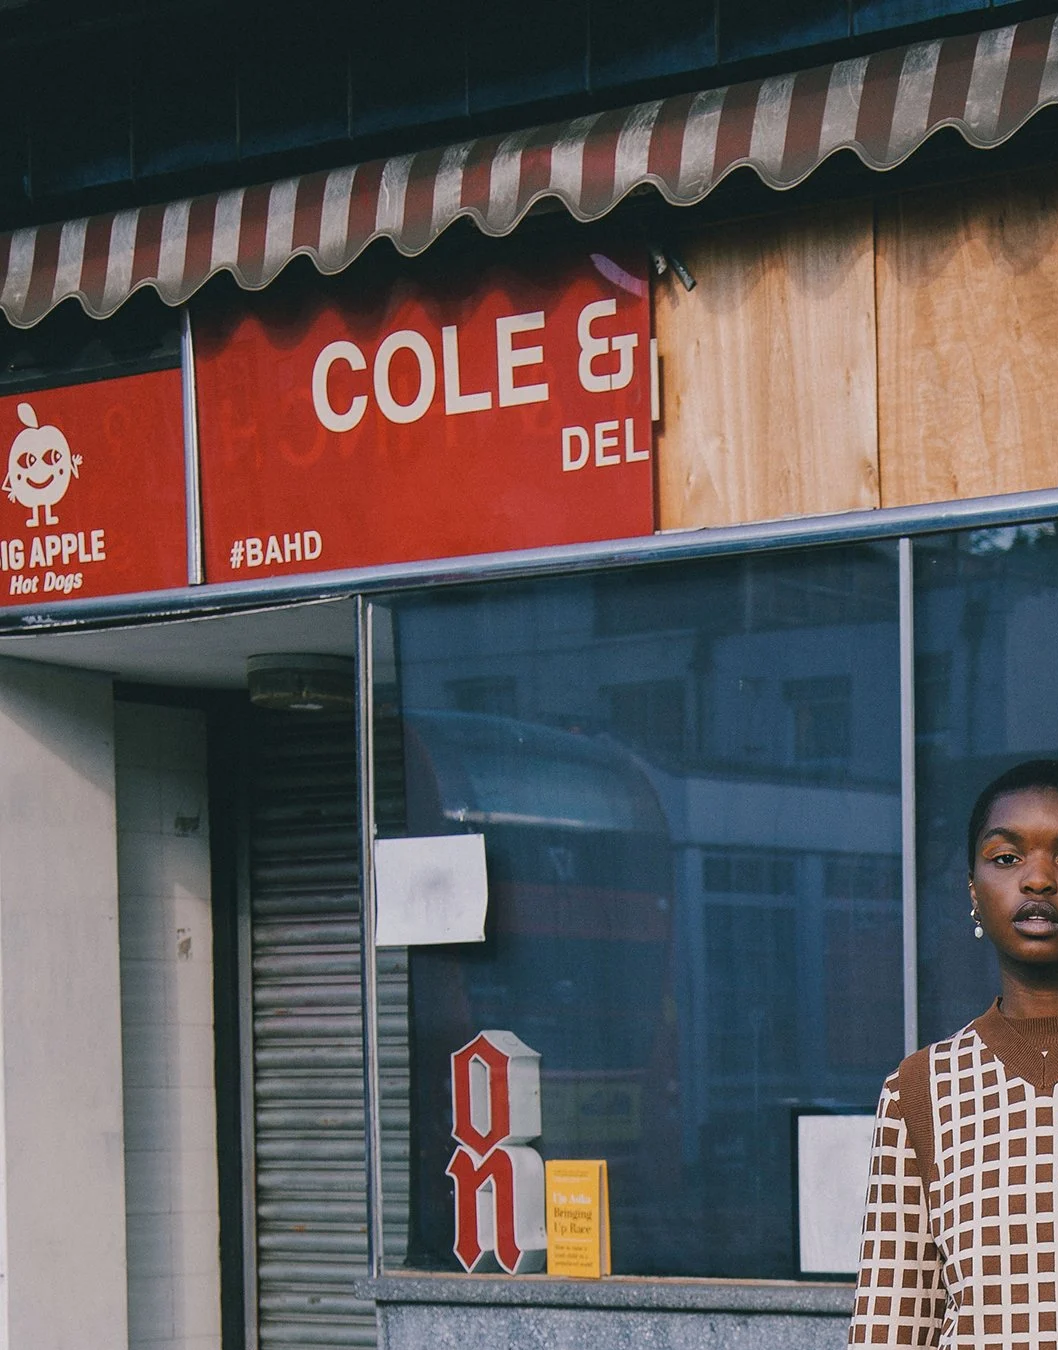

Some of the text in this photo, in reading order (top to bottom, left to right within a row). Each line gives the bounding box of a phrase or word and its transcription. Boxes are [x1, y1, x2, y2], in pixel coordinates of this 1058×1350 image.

[311, 298, 639, 433] COLE &
[0, 529, 106, 572] IG APPLE
[229, 530, 323, 569] #BAHD
[9, 571, 83, 596] Hot Dogs
[553, 1207, 592, 1221] Bringing
